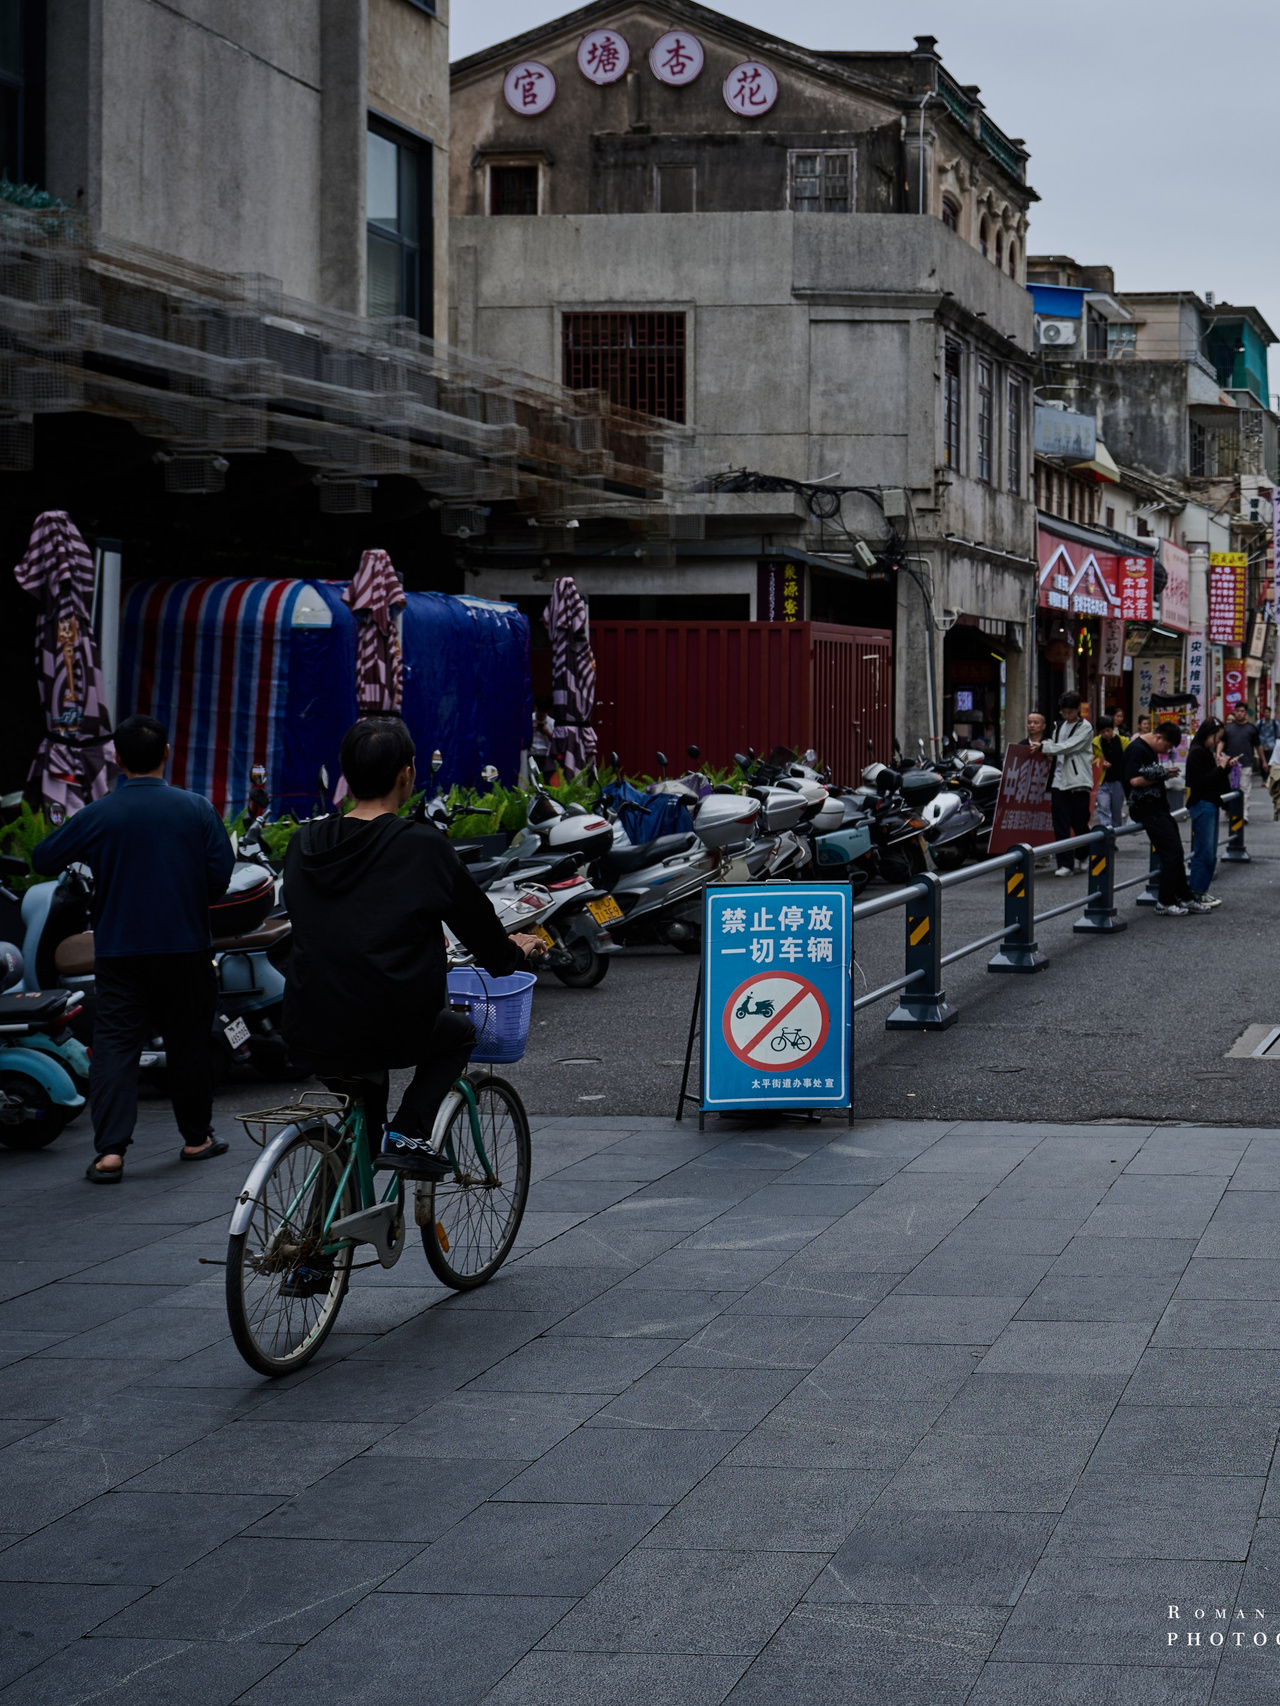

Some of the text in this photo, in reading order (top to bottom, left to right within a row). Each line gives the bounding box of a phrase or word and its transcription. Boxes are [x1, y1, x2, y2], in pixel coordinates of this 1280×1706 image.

[513, 30, 768, 108] 官塘杏花
[721, 905, 834, 934] 禁止停放
[721, 936, 834, 964] 一切车辆
[751, 1078, 835, 1089] 太平街道办事处 宣
